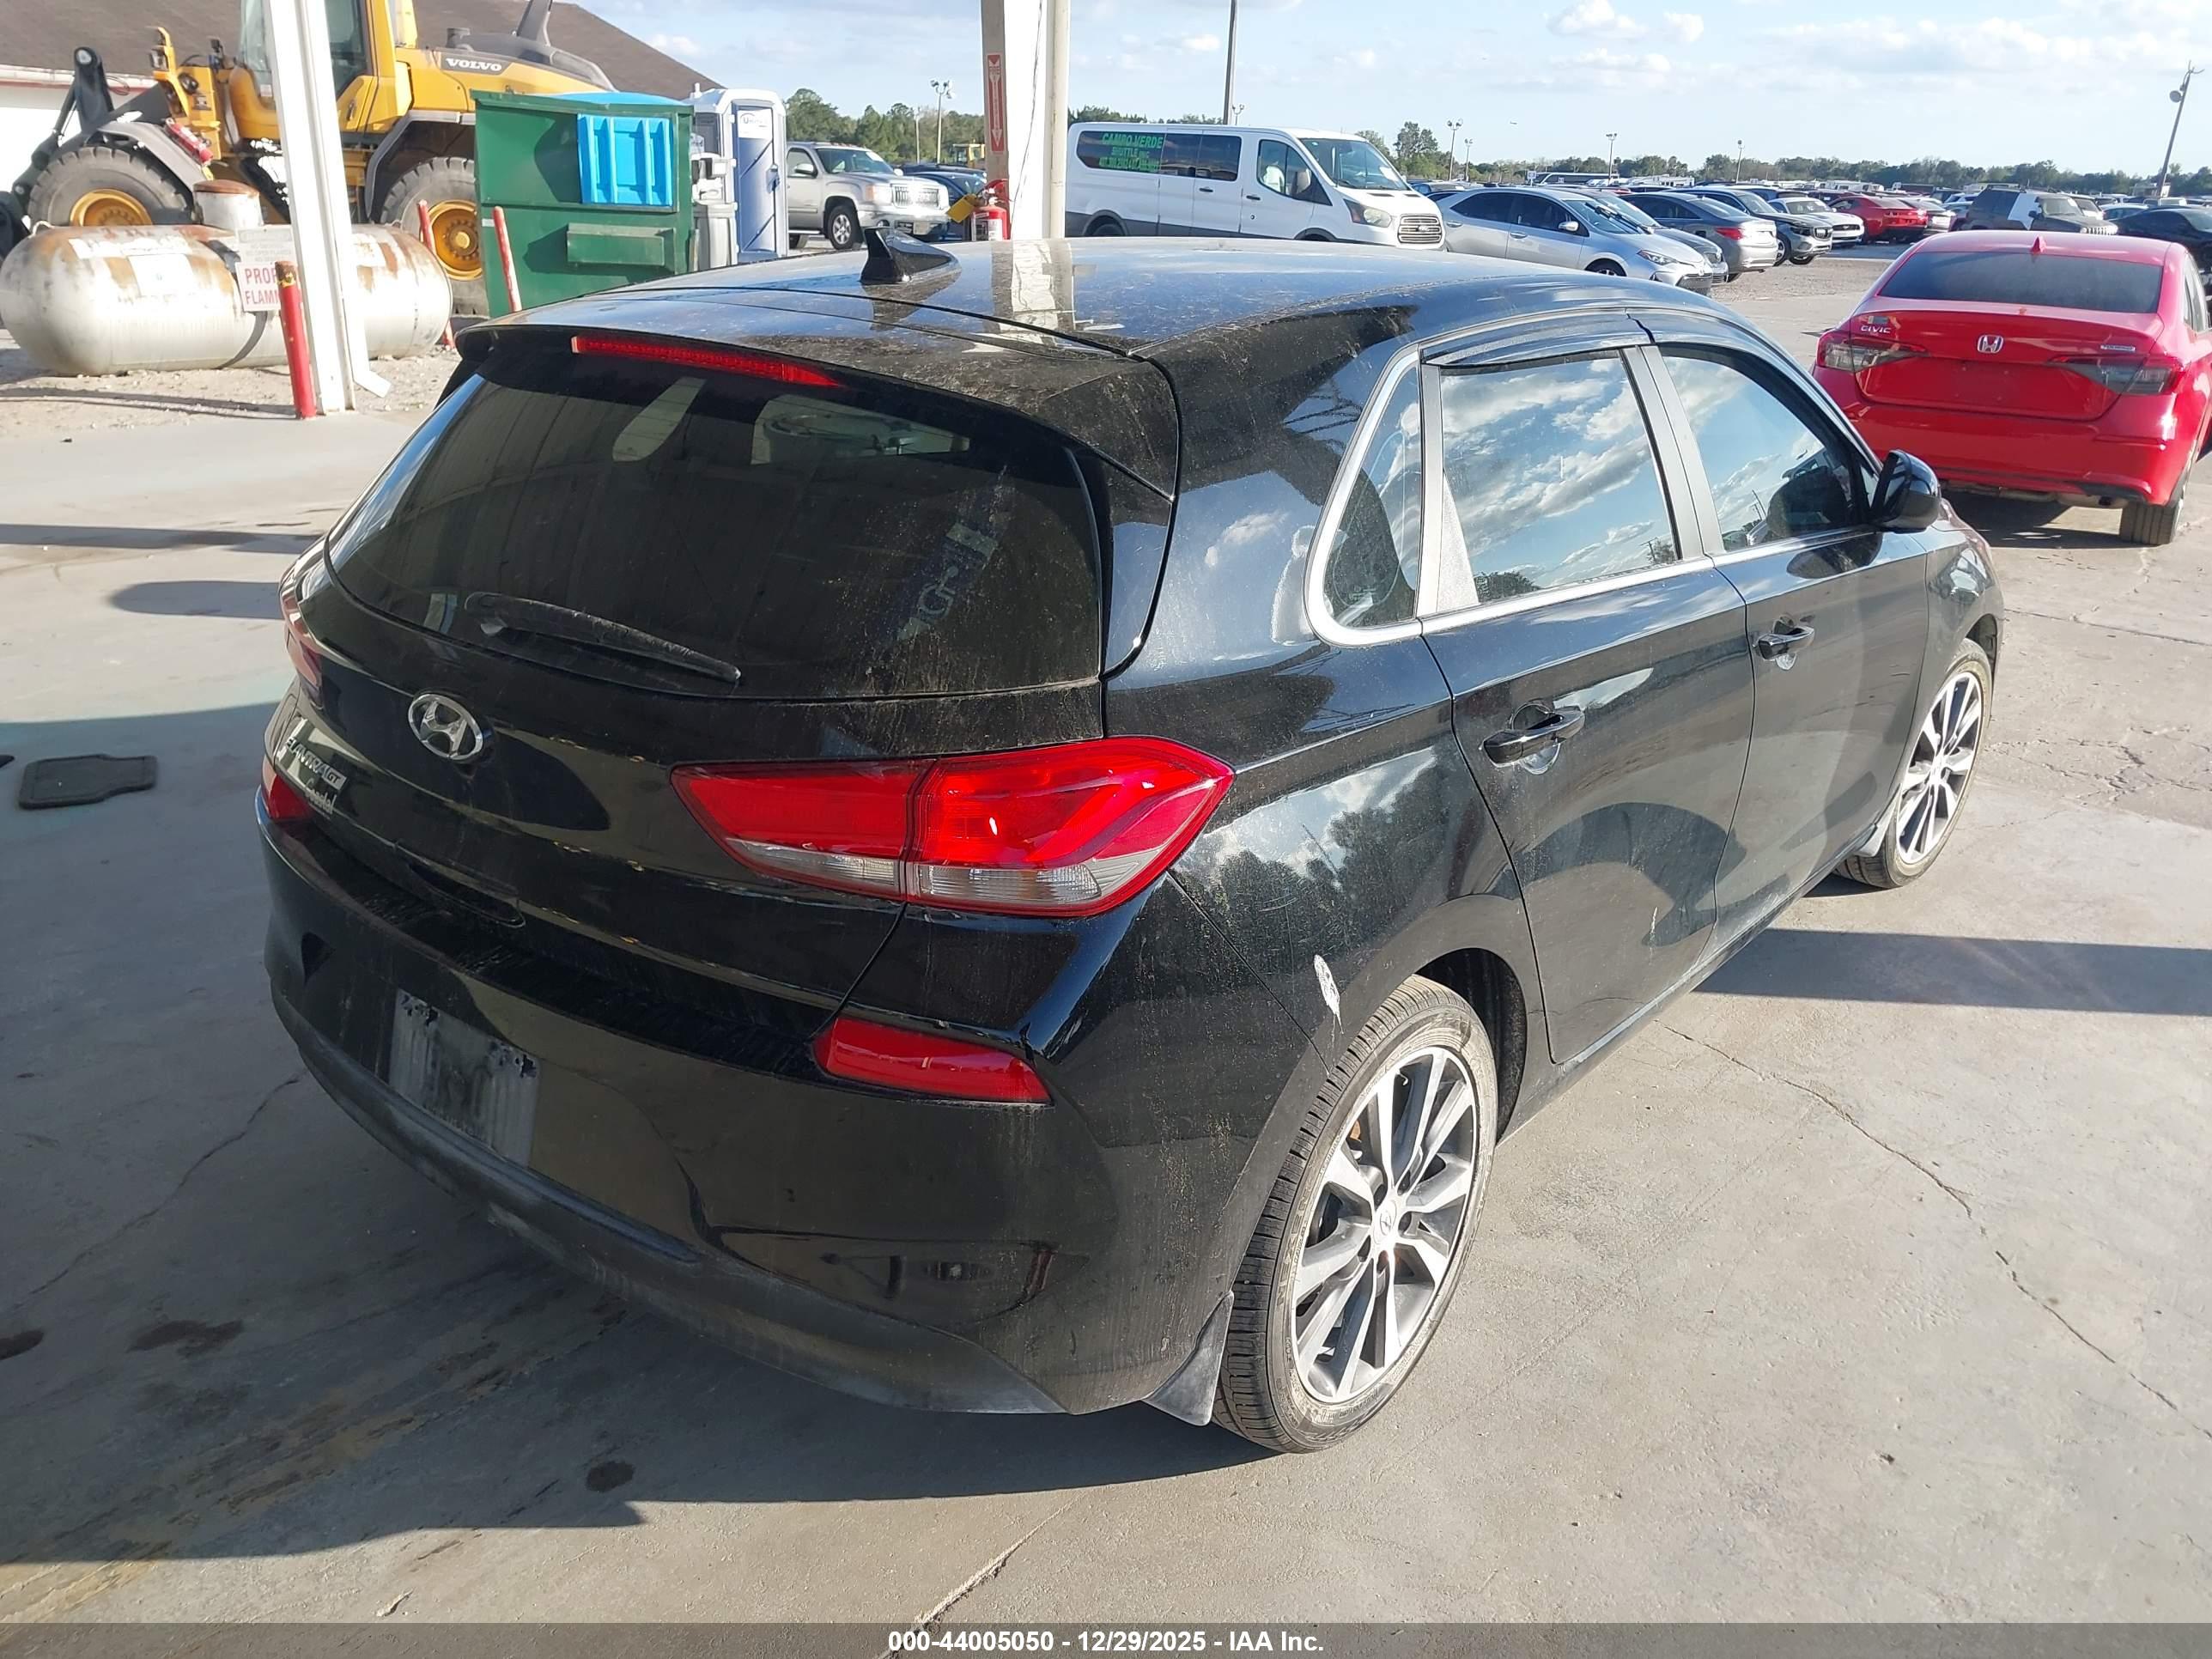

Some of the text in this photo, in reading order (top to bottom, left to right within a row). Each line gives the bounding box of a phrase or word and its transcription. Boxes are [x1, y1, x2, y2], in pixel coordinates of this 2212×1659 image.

[446, 58, 501, 71] VOLVO
[1133, 135, 1163, 149] VERDE
[1861, 325, 1892, 334] CIVIC
[286, 736, 331, 780] ELANTRA
